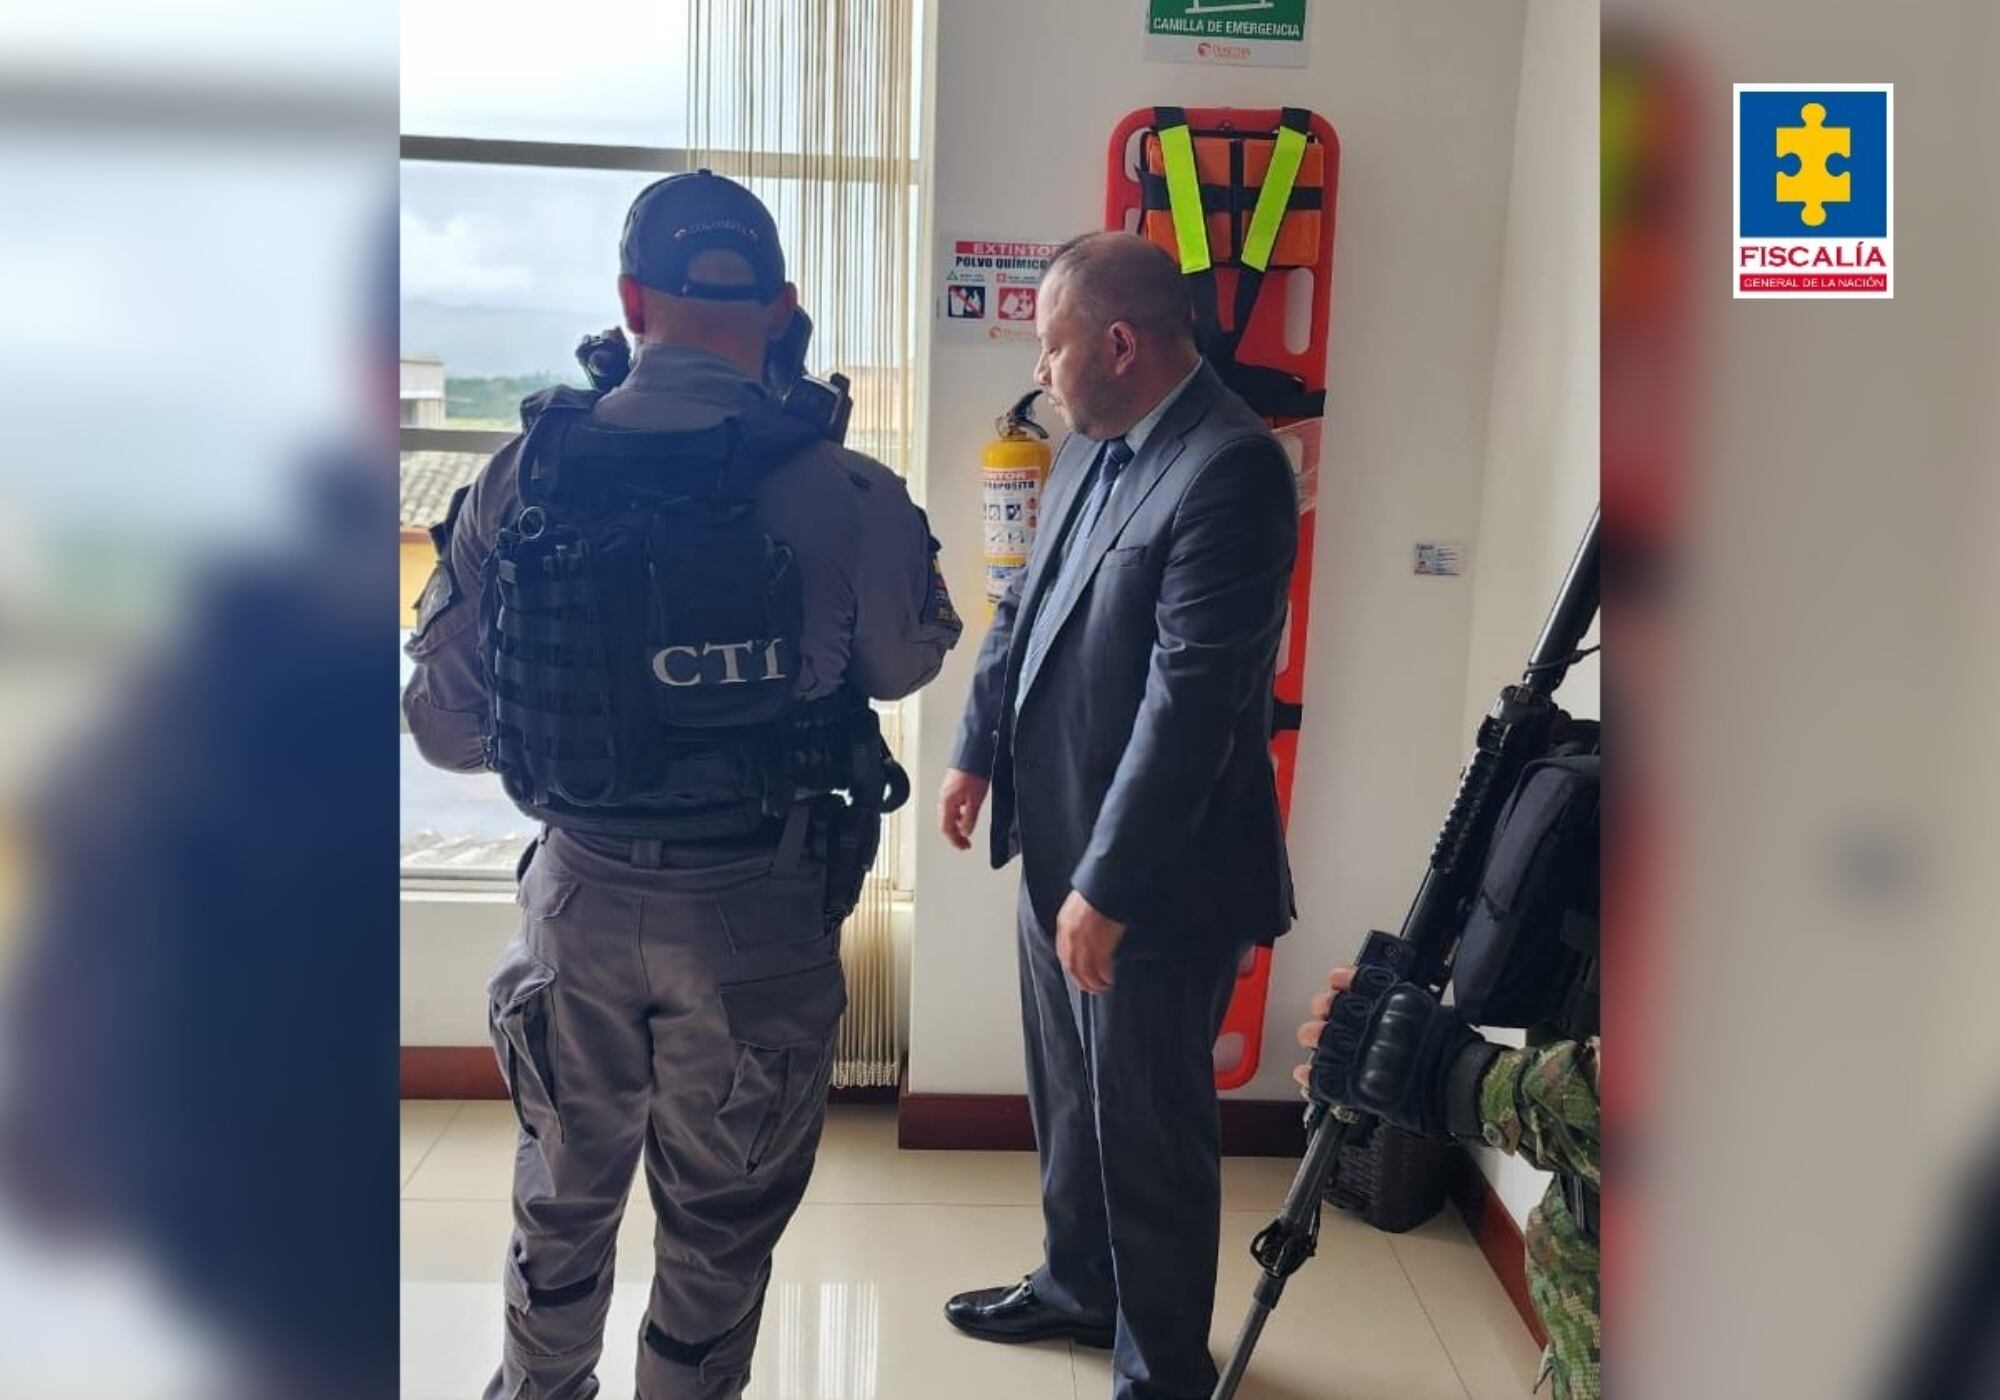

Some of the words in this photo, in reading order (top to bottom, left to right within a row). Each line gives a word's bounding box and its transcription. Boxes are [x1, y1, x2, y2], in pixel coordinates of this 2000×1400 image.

[1153, 17, 1204, 32] CAMILLA
[1207, 20, 1223, 33] DE
[1226, 20, 1300, 36] EMERGENCIA
[956, 256, 993, 268] POLVO
[653, 638, 786, 686] CTI
